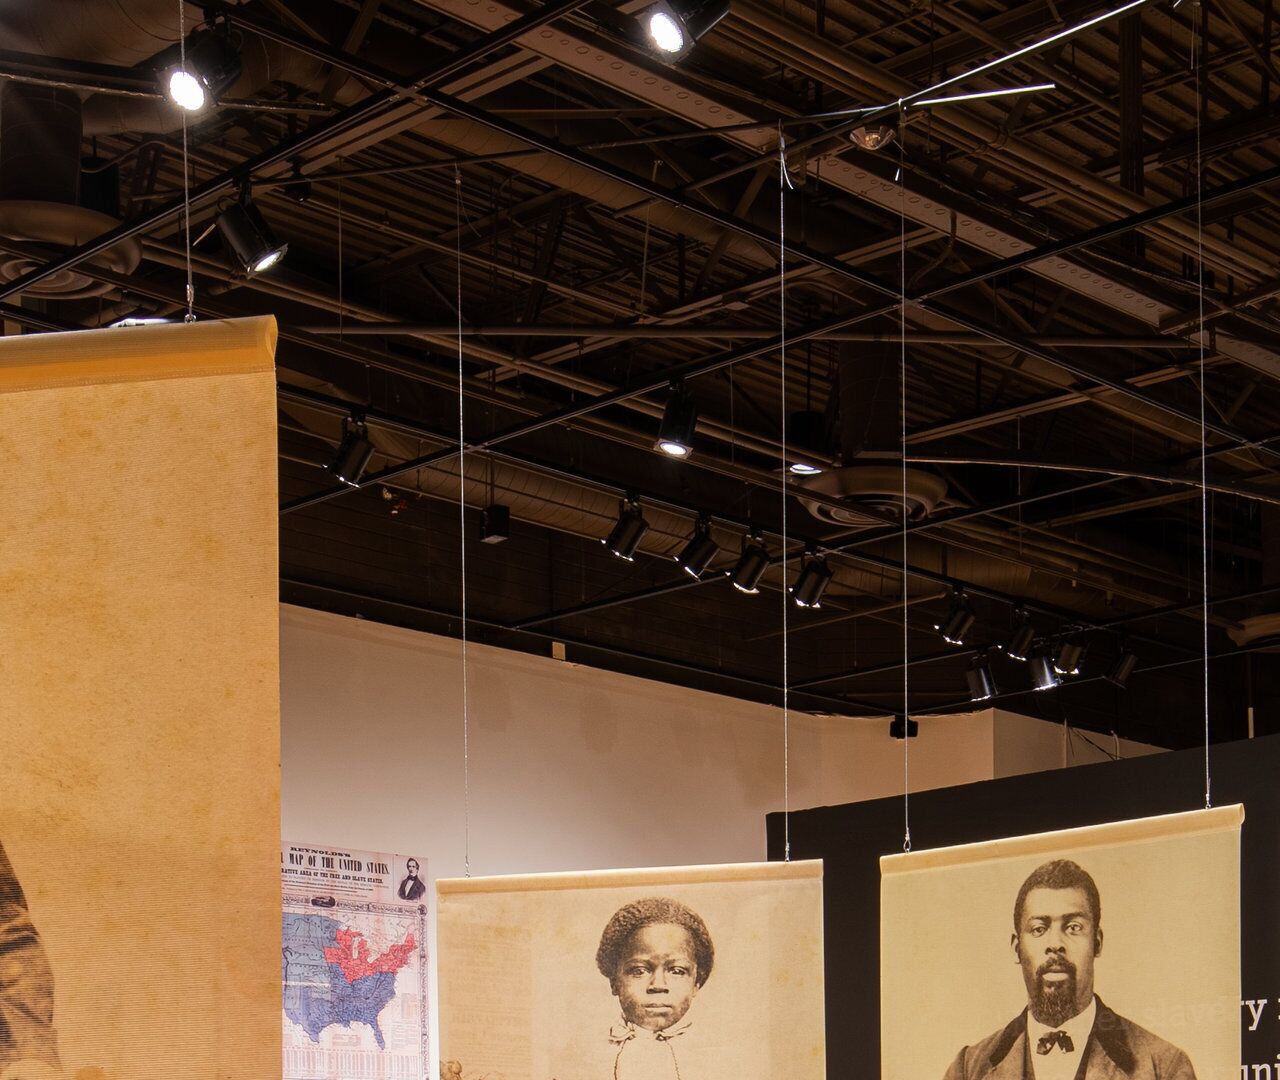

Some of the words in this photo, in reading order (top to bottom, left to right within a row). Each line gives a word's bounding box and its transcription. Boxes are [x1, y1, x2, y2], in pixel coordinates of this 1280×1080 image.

[289, 853, 304, 866] MAP
[308, 856, 317, 868] OF
[322, 856, 334, 869] THE
[339, 858, 362, 872] UNITED
